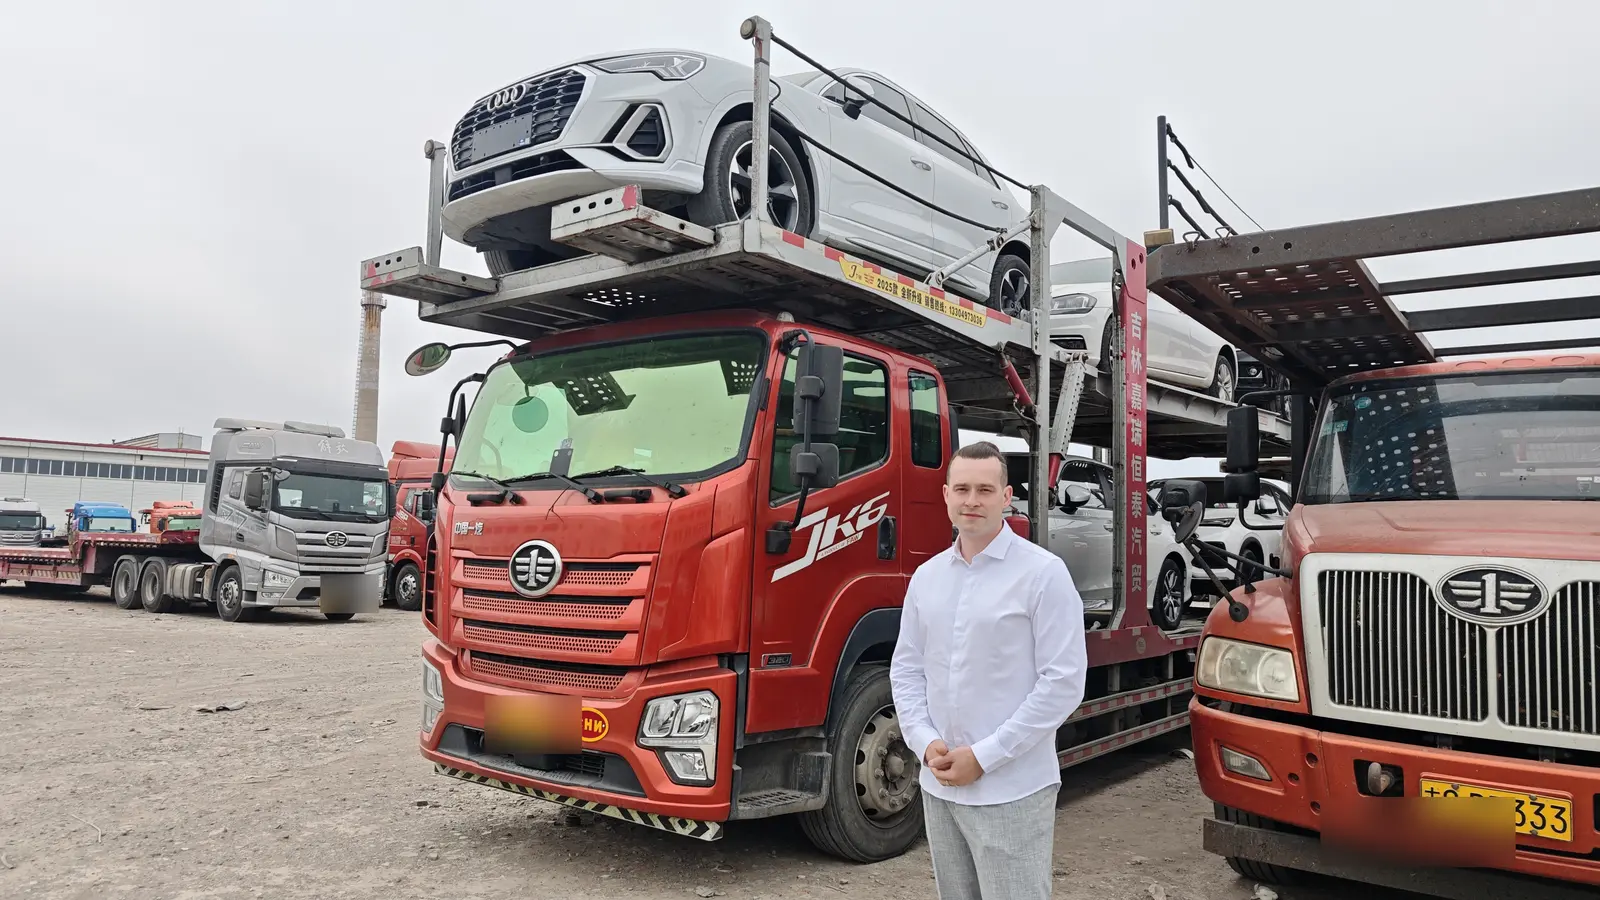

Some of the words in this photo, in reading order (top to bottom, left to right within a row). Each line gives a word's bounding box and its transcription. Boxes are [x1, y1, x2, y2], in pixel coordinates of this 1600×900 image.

[901, 286, 922, 304] 全新升级
[1131, 311, 1142, 593] 吉林嘉瑞恒泰汽贸
[454, 521, 484, 536] 中国一汽
[771, 491, 890, 583] JK6
[583, 717, 603, 733] НИ
